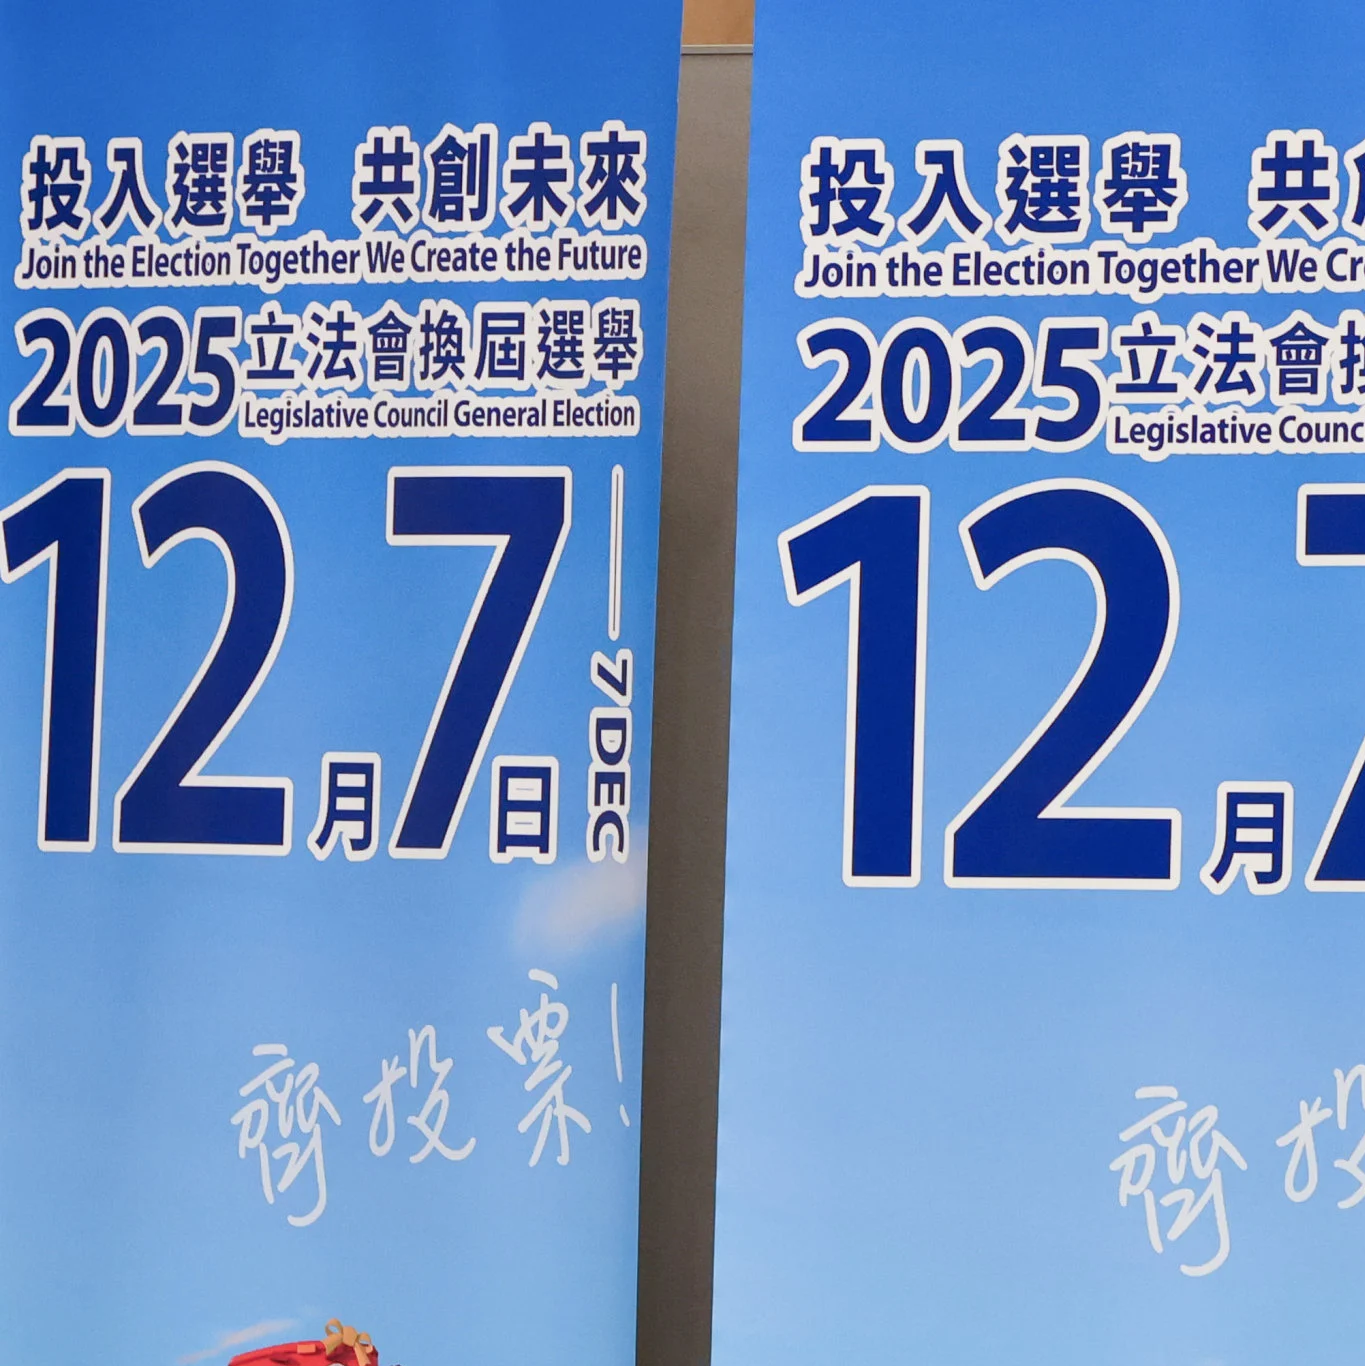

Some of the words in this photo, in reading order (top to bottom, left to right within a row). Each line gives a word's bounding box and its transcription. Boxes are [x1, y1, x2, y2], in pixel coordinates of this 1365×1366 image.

[28, 139, 297, 231] 投入選舉
[359, 130, 640, 224] 共創未來
[809, 142, 1178, 236] 投入選舉
[22, 246, 76, 279] Join
[83, 245, 125, 278] the
[132, 243, 231, 277] Election
[236, 240, 361, 283] Together
[366, 241, 405, 273] We
[411, 239, 498, 273] Create
[505, 237, 551, 271] the
[558, 238, 642, 270] Future
[804, 253, 876, 288] Join
[886, 252, 943, 287] the
[953, 250, 1090, 286] Election
[1097, 248, 1260, 294] Together
[1266, 249, 1317, 283] We
[16, 316, 236, 428] 2025
[247, 307, 637, 382] 立法會換屆選舉
[802, 326, 1101, 443] 2025
[245, 400, 369, 435] Legislative
[374, 399, 448, 428] Council
[454, 399, 547, 427] General
[553, 398, 635, 427] Election
[1115, 414, 1272, 452] Legislative
